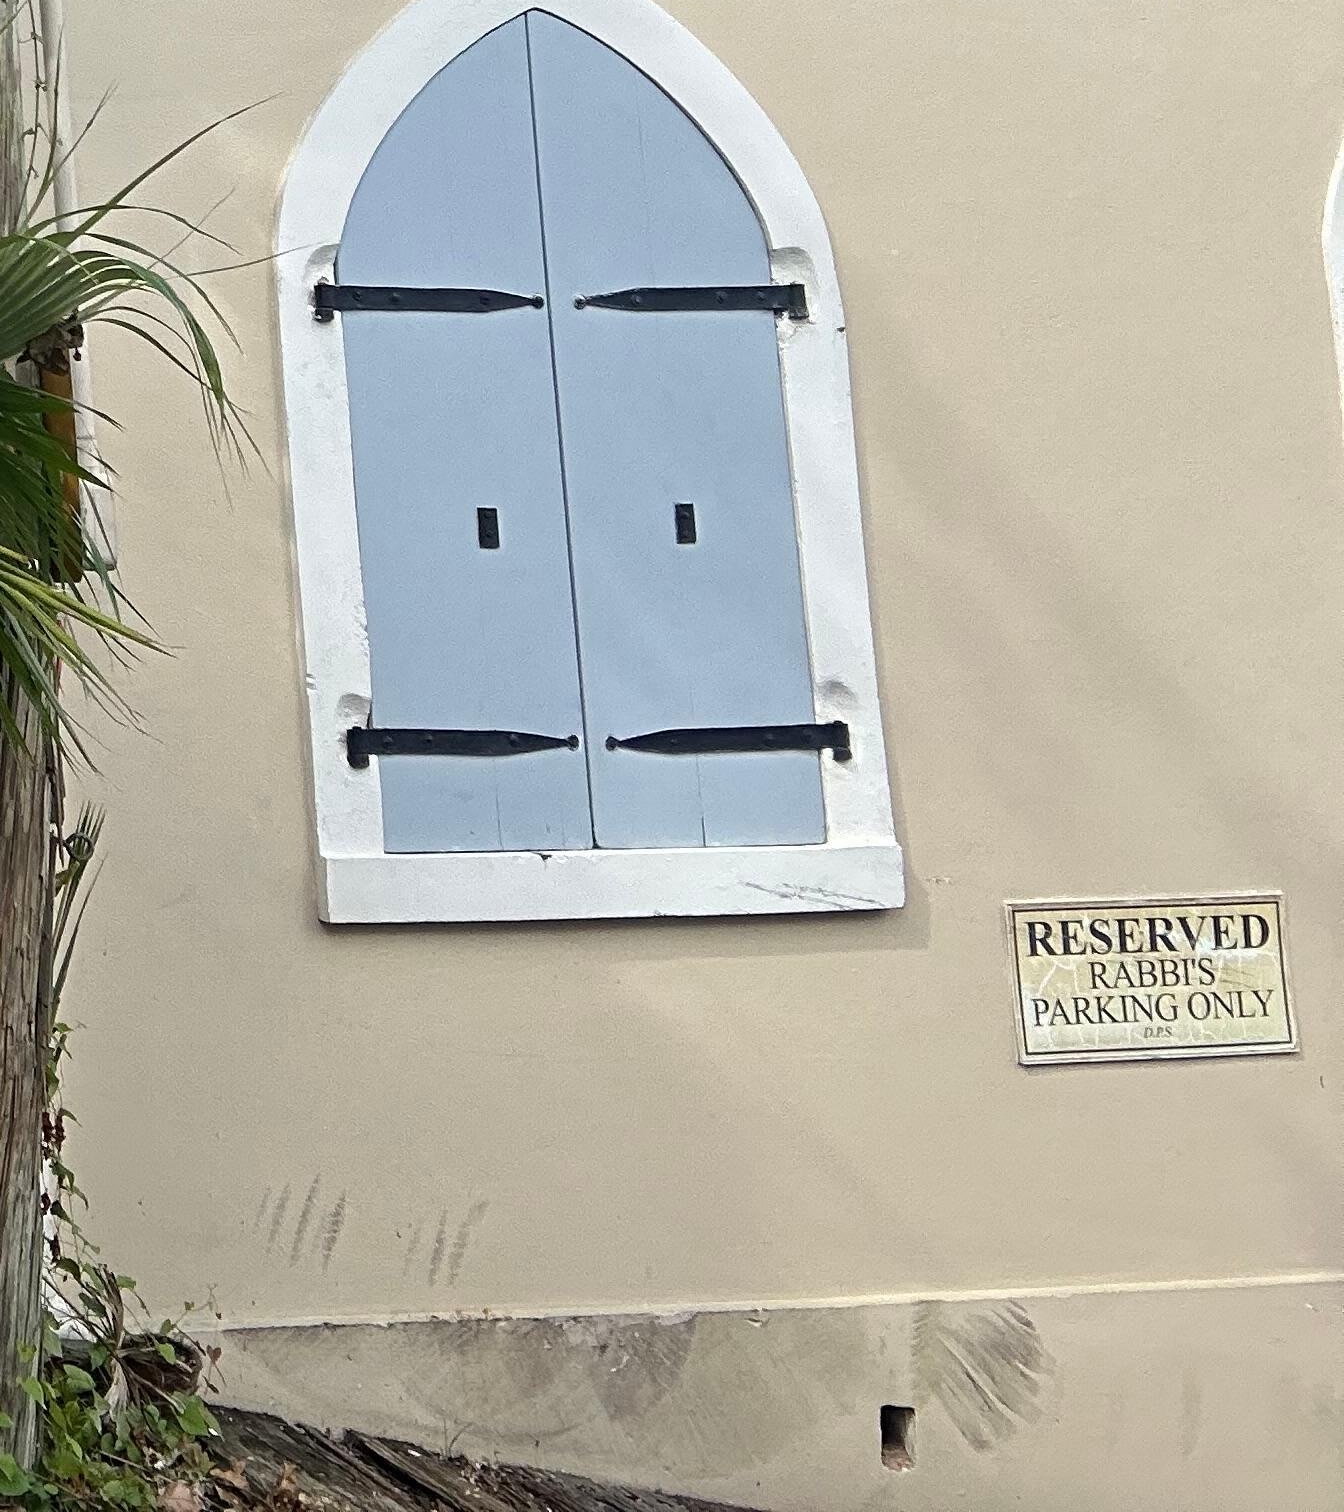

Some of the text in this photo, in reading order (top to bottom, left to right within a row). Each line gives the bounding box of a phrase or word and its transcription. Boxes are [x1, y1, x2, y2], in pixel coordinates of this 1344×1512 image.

[1023, 913, 1271, 957] RESERVED
[1088, 957, 1216, 990] RABBI'S
[1031, 989, 1275, 1027] PARKING ONLY
